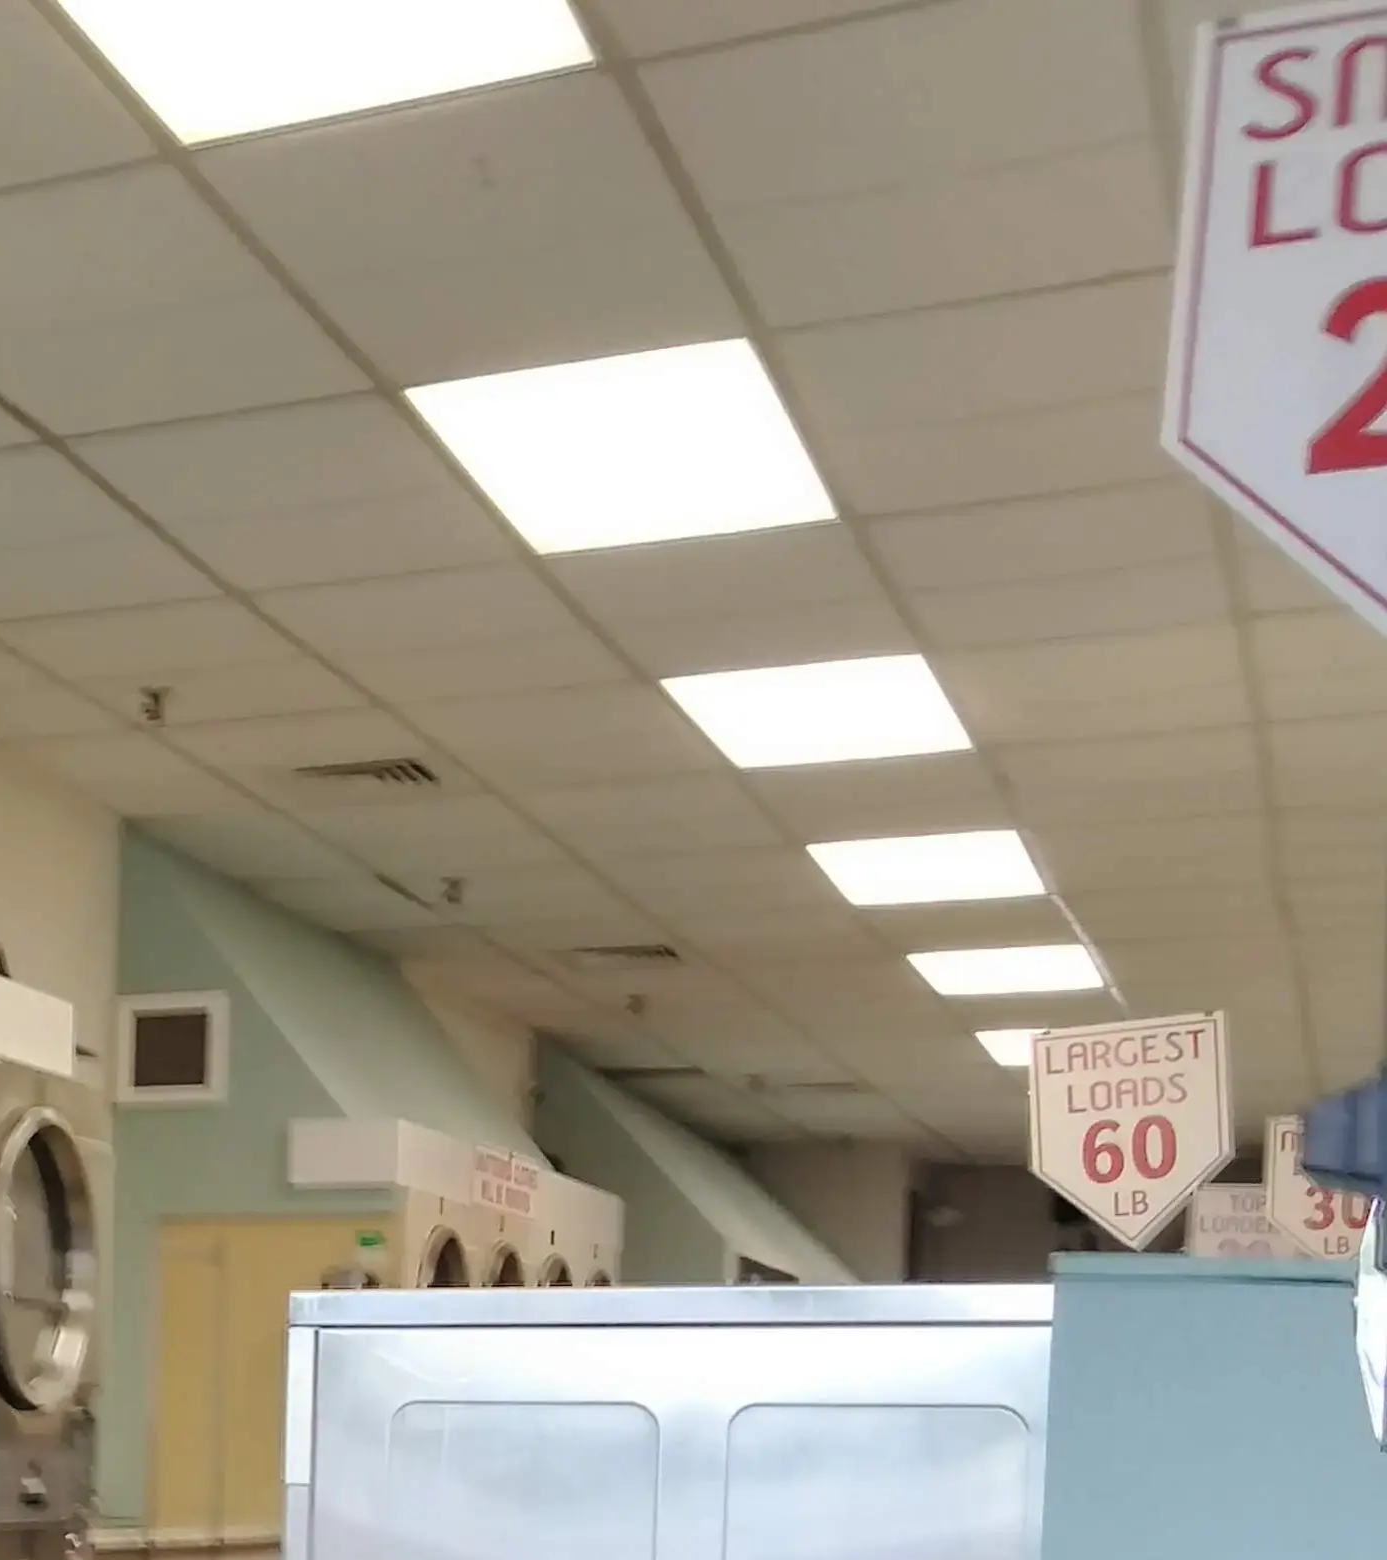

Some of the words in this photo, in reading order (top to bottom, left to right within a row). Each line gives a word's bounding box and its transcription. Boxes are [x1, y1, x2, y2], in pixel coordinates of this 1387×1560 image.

[1044, 1028, 1206, 1075] LARGEST
[1067, 1072, 1188, 1114] LOADS
[1082, 1114, 1178, 1184] 60
[1113, 1189, 1149, 1217] LB
[1302, 1186, 1369, 1230] 30
[1323, 1235, 1350, 1255] LB
